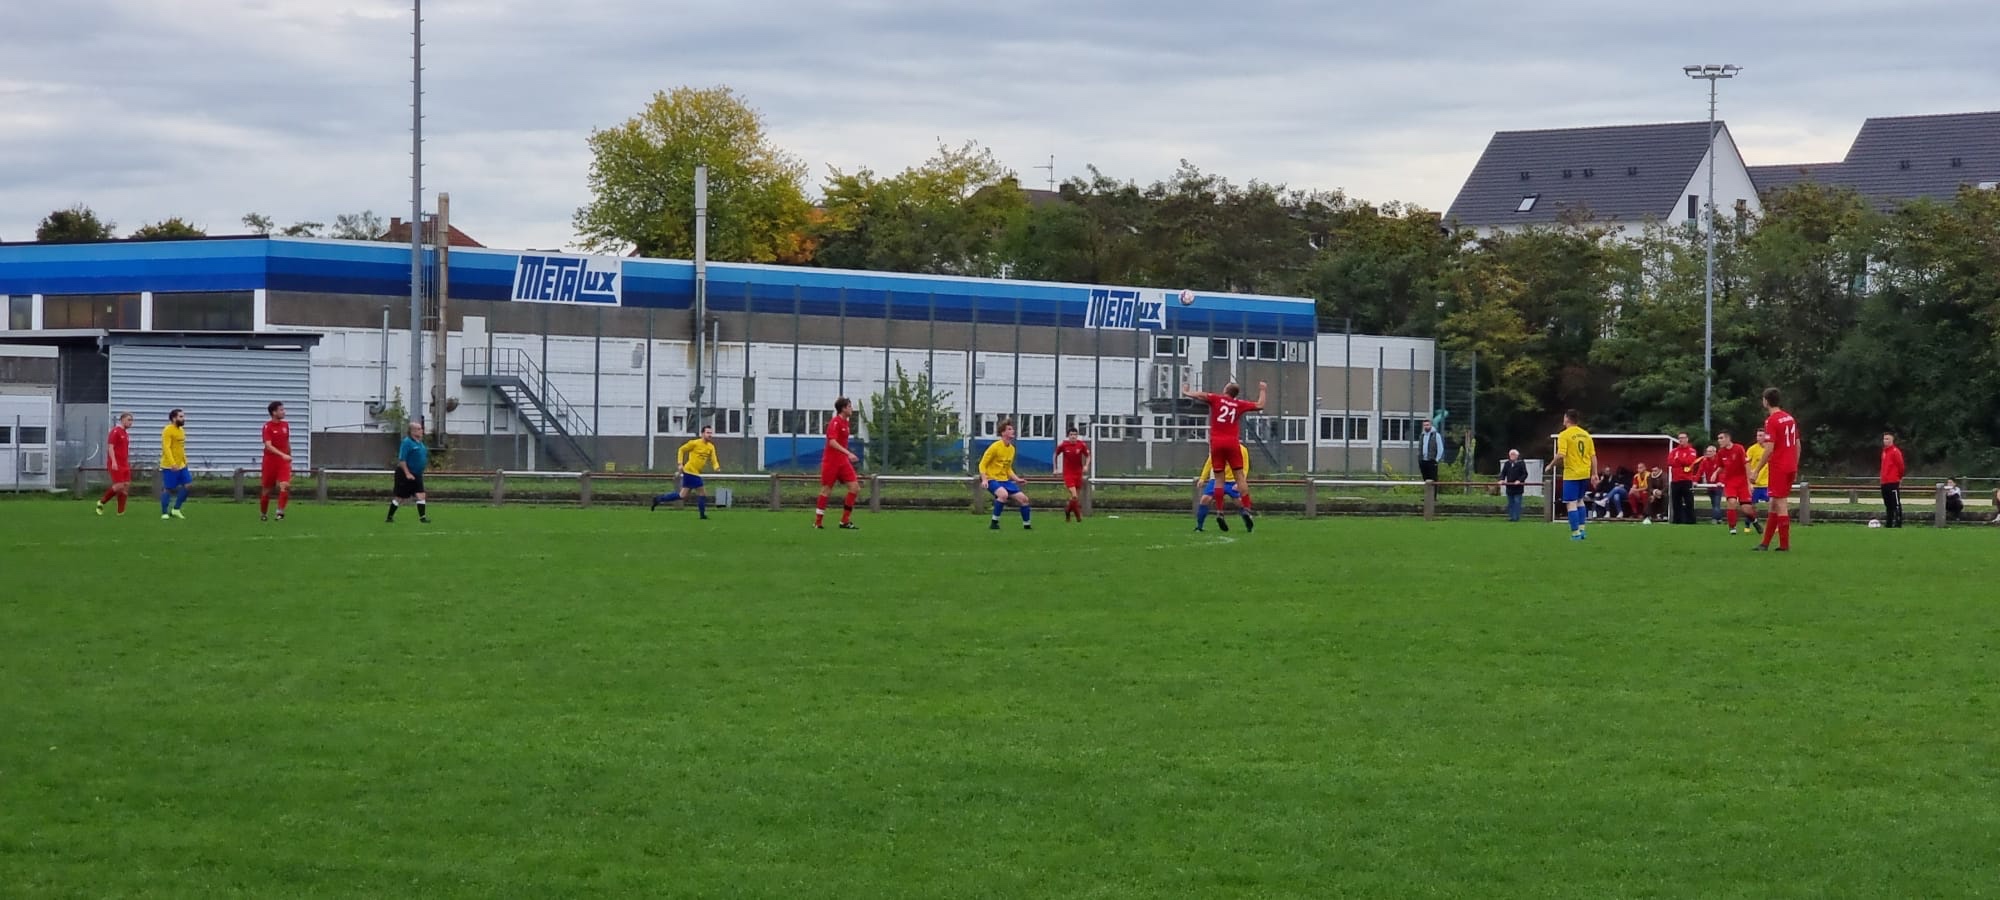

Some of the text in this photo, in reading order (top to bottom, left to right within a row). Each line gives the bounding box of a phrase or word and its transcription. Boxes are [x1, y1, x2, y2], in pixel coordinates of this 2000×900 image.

[1217, 405, 1236, 423] 21
[1785, 423, 1796, 447] 11
[1578, 440, 1585, 457] 9
